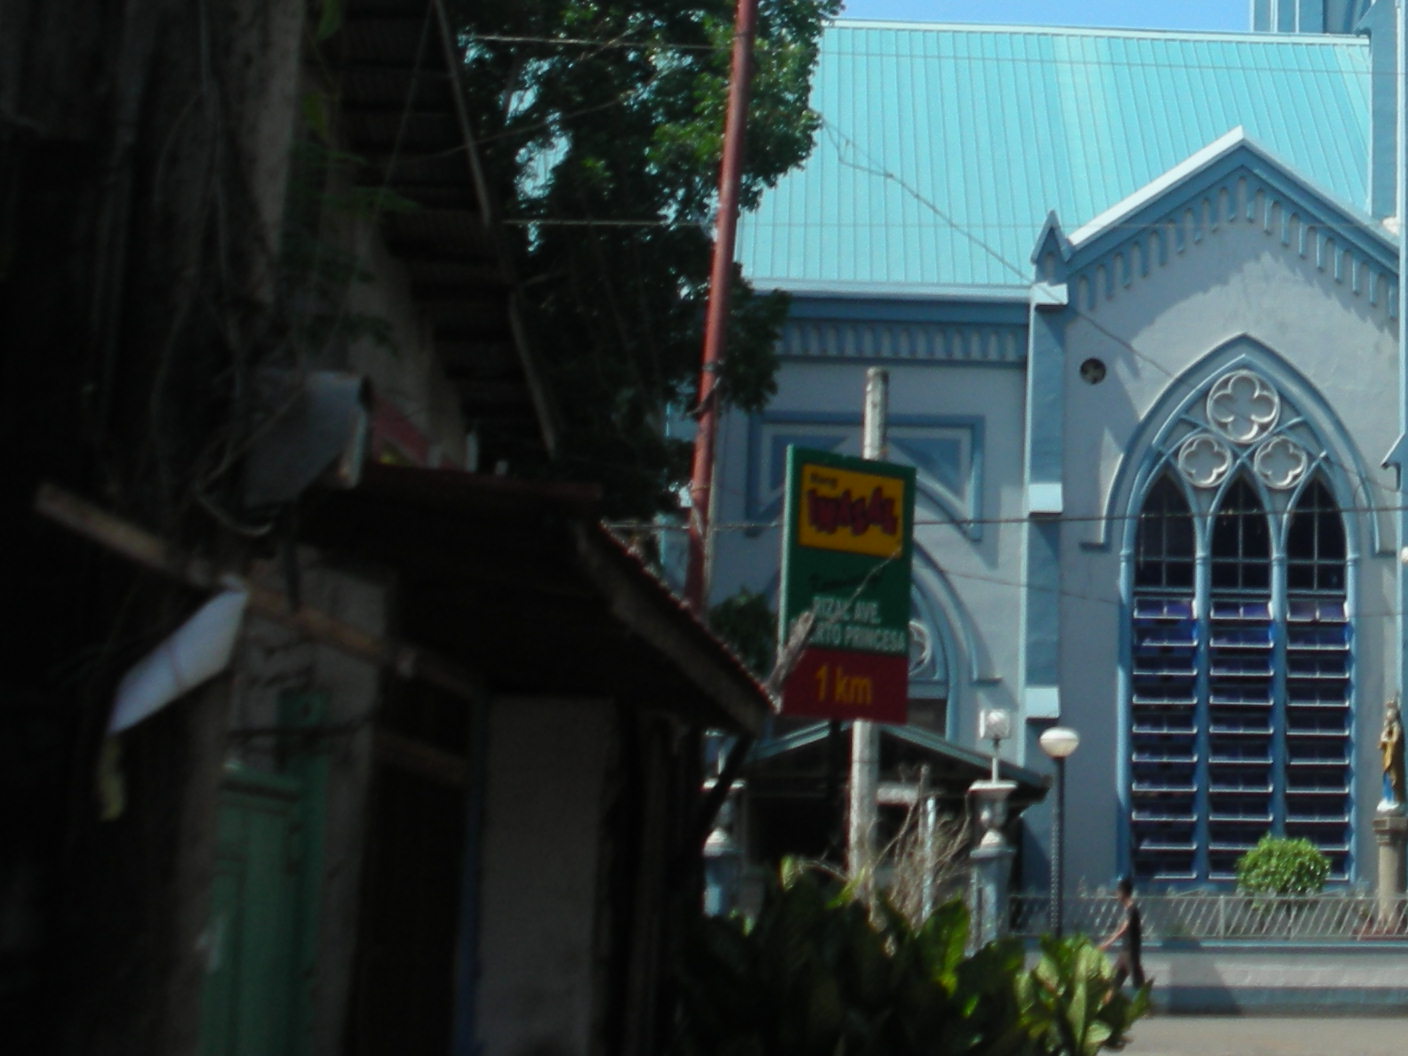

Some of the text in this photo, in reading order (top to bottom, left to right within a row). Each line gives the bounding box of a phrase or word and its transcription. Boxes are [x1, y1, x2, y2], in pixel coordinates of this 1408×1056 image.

[844, 624, 907, 653] PRINCESA
[816, 664, 873, 705] 1 km
